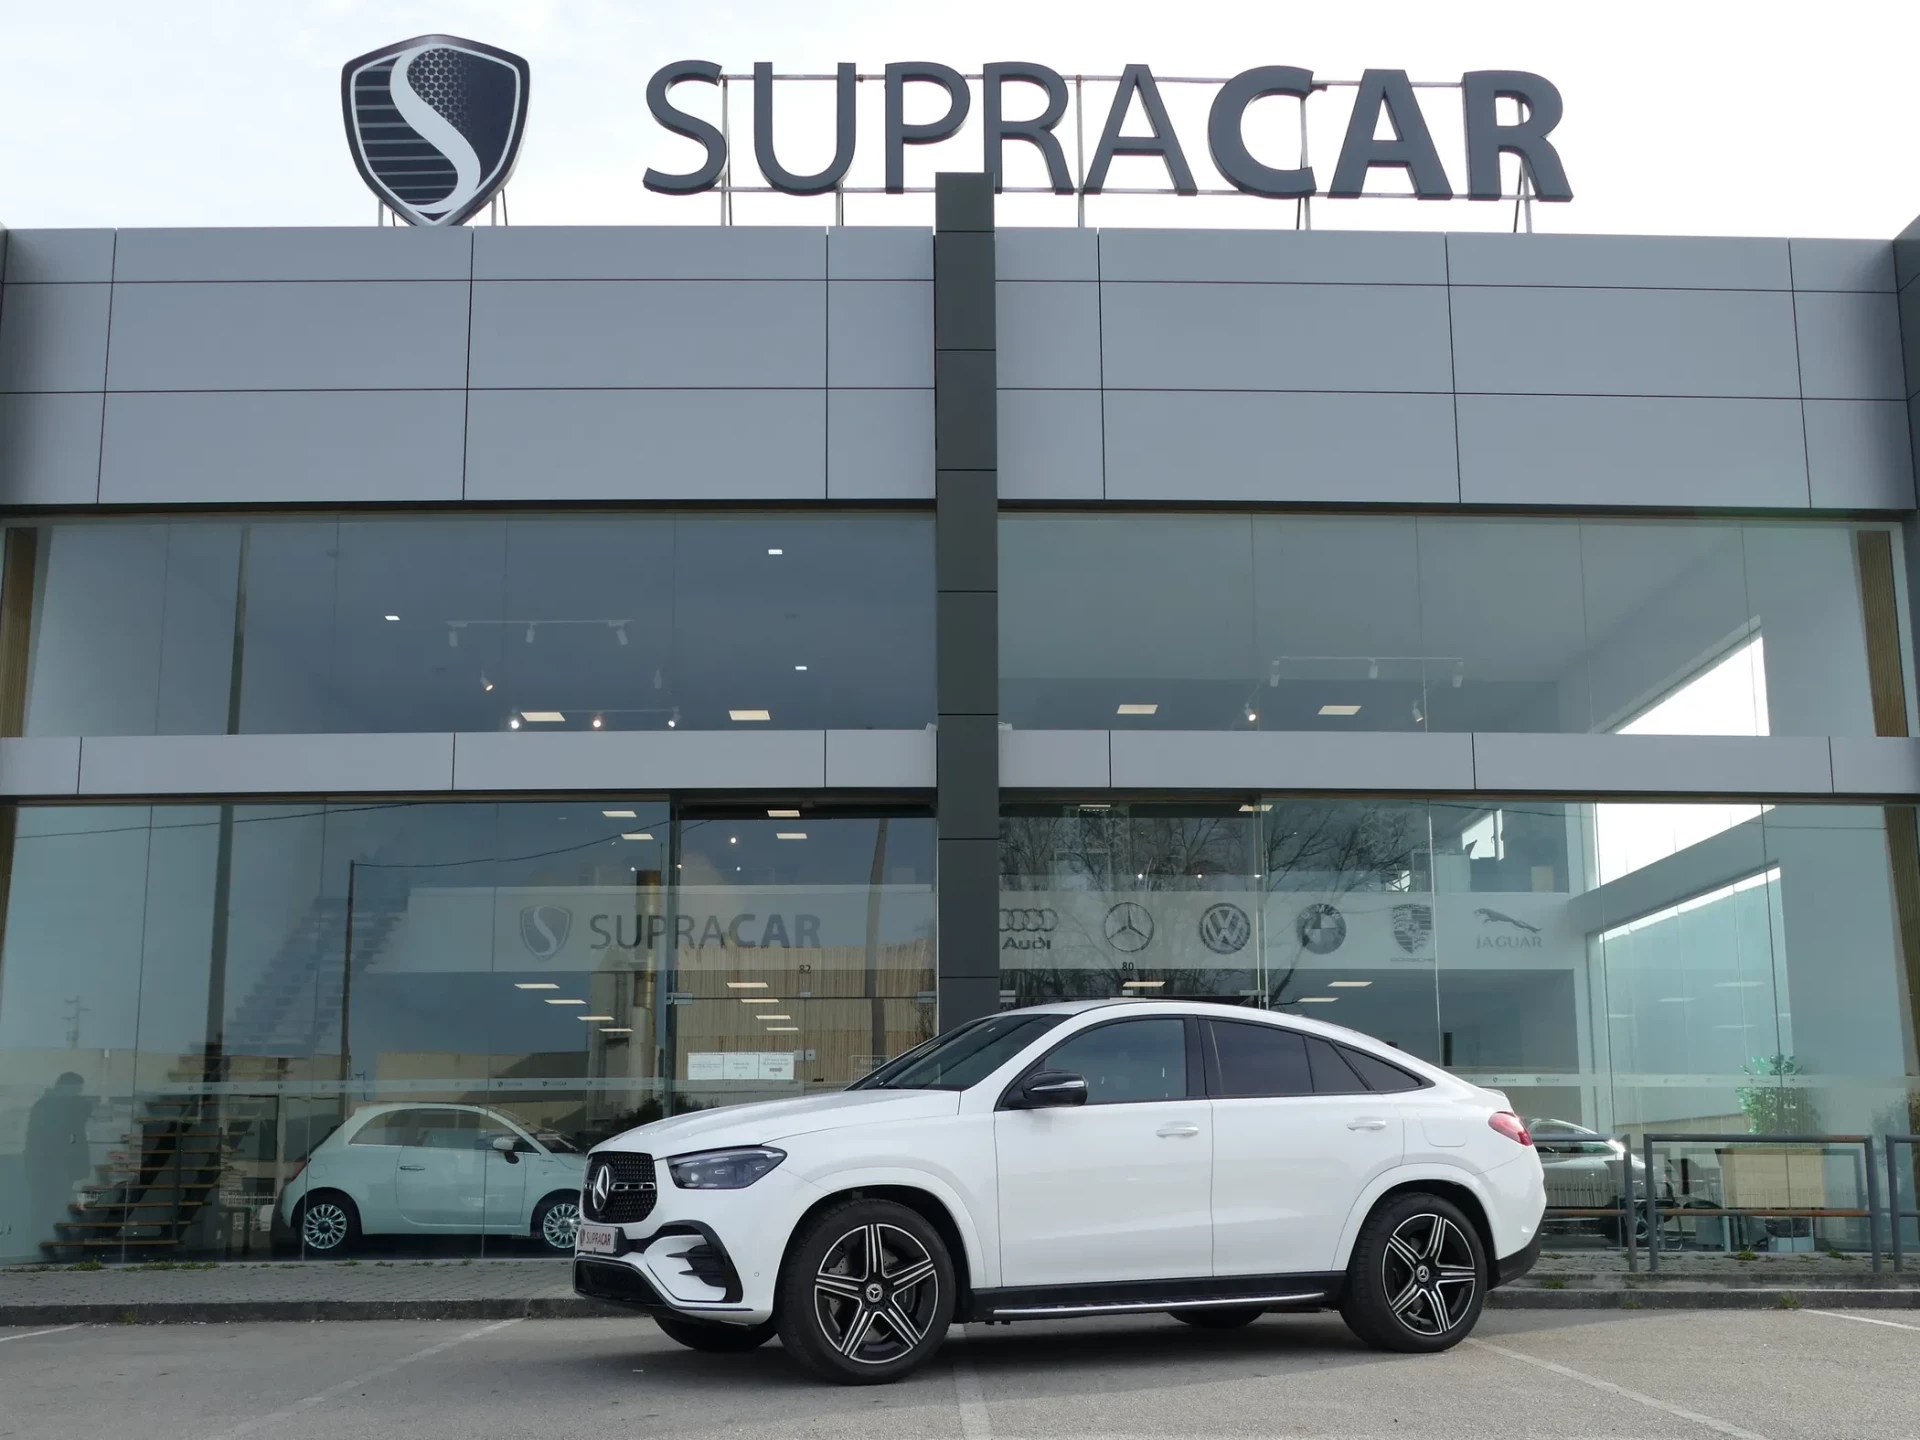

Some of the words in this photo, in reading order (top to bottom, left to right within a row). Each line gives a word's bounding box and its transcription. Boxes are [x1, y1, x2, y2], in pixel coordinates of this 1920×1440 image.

[643, 60, 1573, 202] SUPRACAR
[589, 914, 822, 949] SUPRACAR
[1002, 936, 1051, 950] Audi
[1475, 934, 1543, 949] JAGUAR
[799, 964, 811, 974] 82
[1122, 962, 1134, 971] 80
[586, 1231, 611, 1246] SUPRACAR
